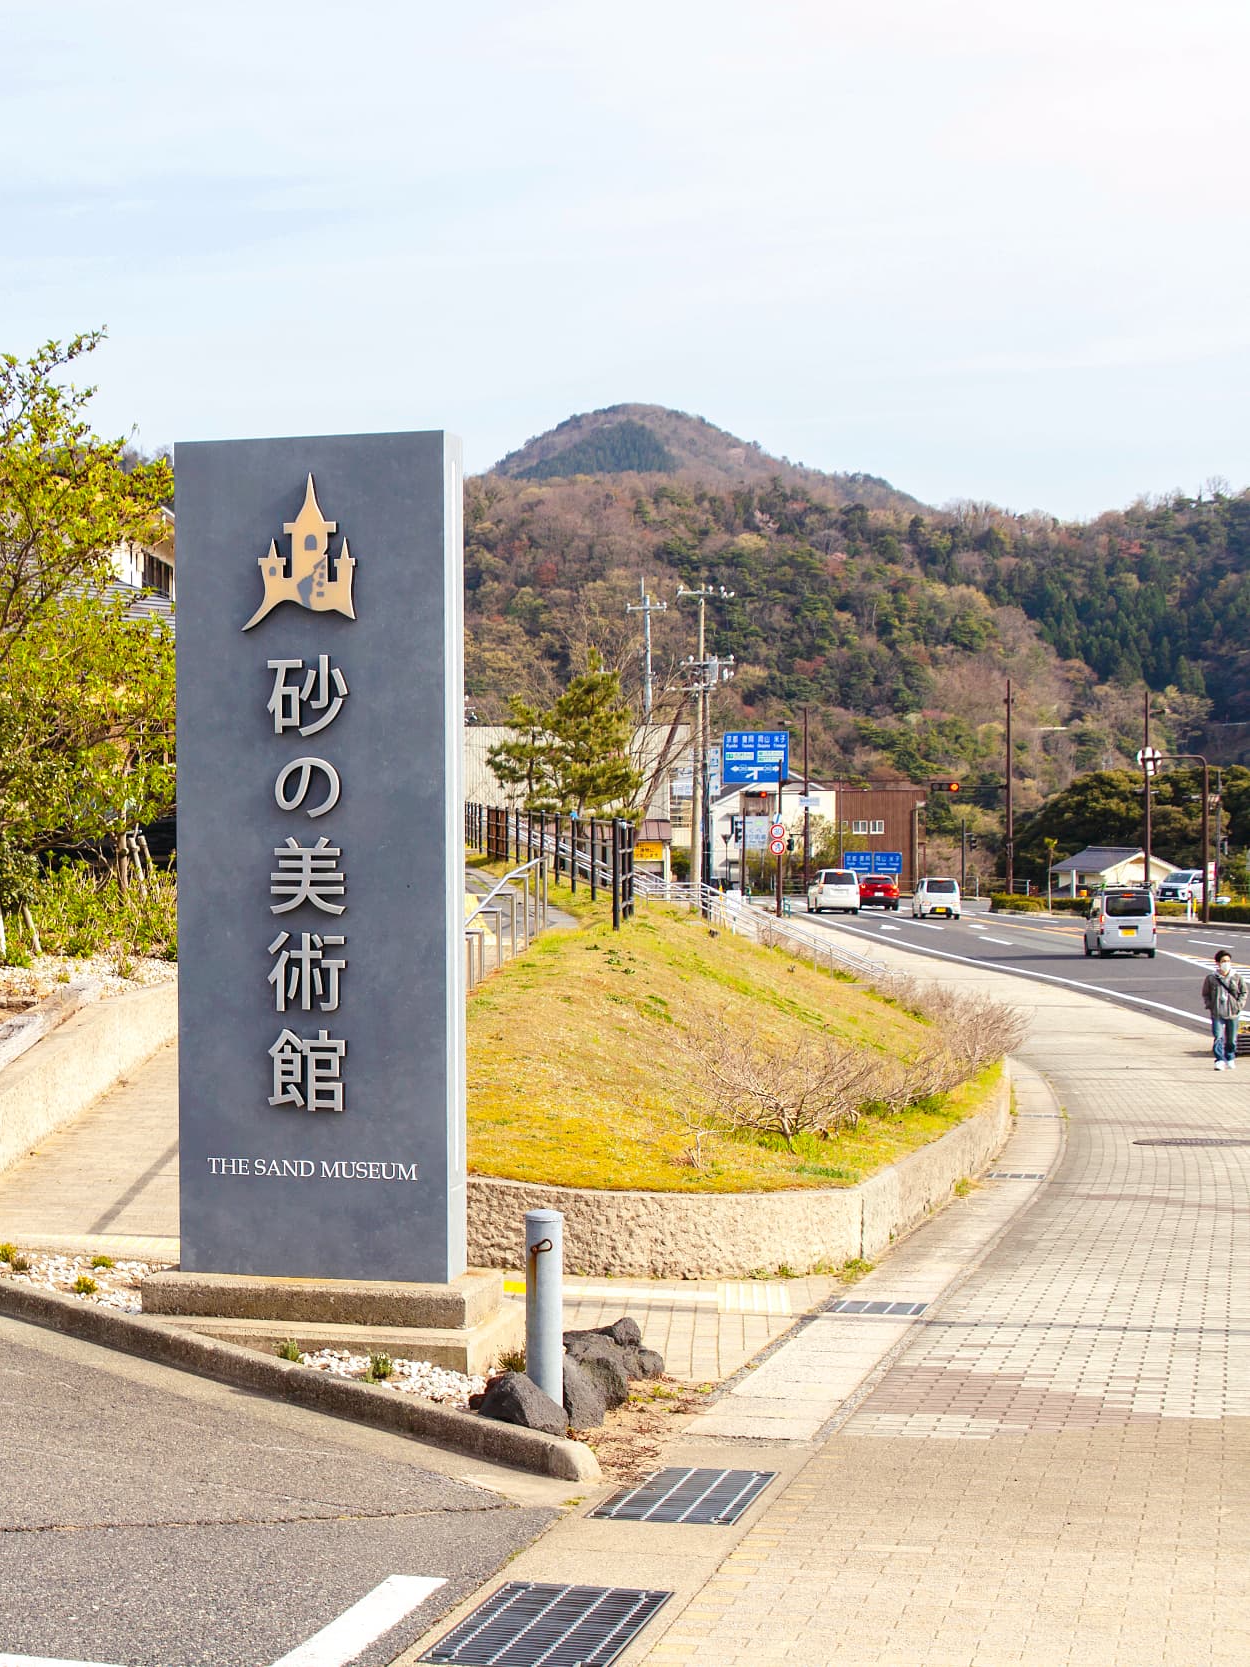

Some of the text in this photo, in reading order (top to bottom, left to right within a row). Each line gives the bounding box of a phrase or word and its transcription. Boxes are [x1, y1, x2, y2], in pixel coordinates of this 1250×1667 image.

[266, 654, 349, 1112] 砂の美術館
[206, 1157, 419, 1181] THE SAND MUSEUM
